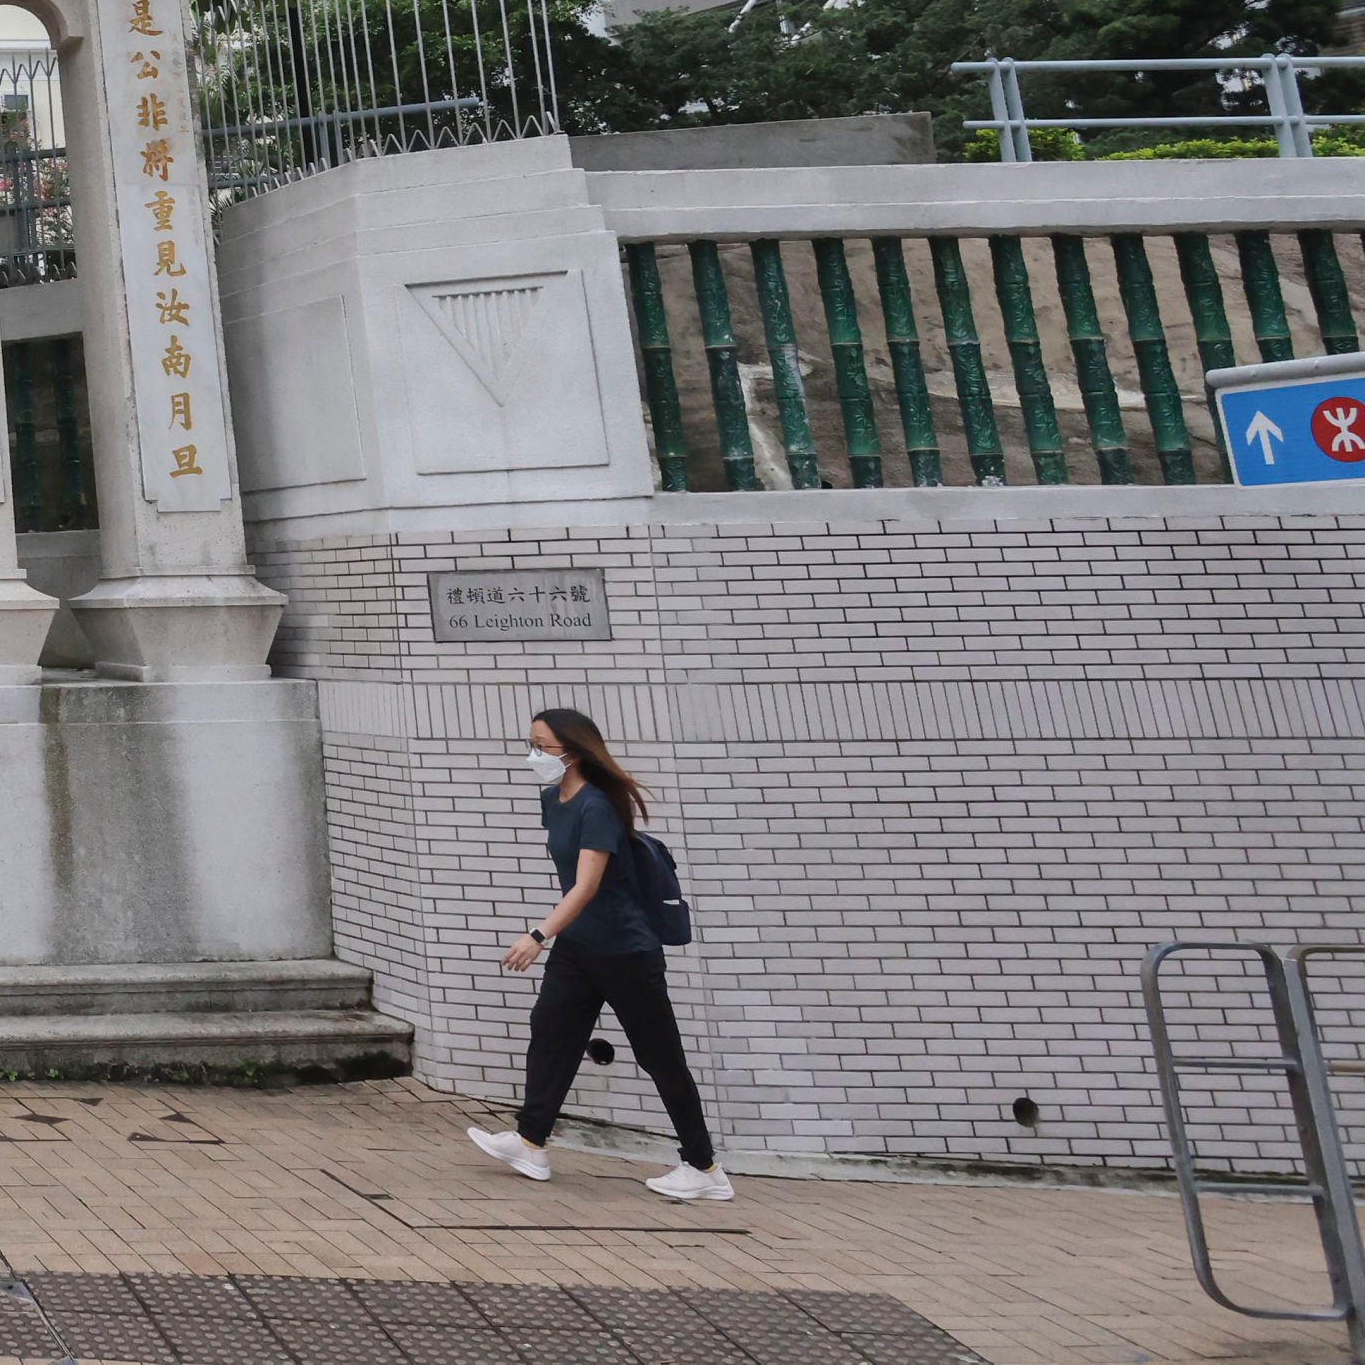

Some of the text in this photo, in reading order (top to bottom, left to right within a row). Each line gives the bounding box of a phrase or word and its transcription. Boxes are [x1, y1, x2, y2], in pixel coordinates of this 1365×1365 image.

[446, 585, 591, 605] 禮頓道六十六號
[448, 612, 592, 632] 66 Leighton Road
